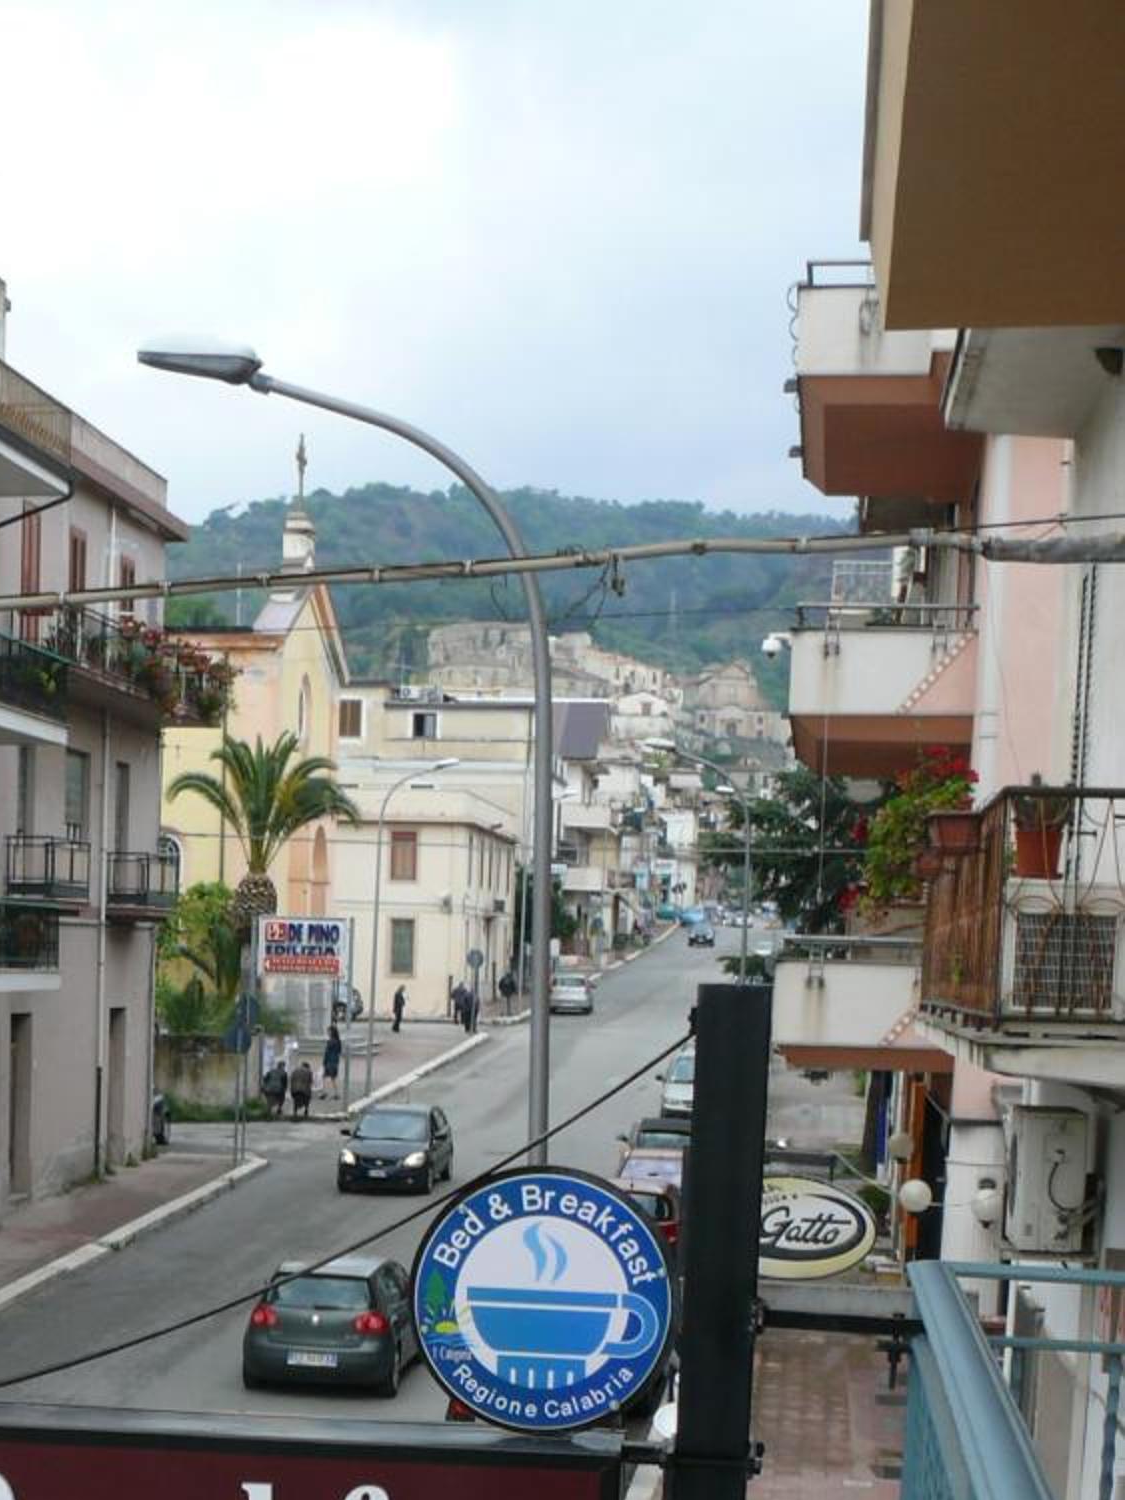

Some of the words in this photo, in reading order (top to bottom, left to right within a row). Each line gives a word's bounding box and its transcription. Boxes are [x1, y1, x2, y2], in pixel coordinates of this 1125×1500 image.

[266, 945, 336, 956] EDILIZIA
[433, 1208, 485, 1269] Bed
[487, 1192, 514, 1221] &
[520, 1184, 660, 1286] Breakfast
[762, 1205, 852, 1246] Gatto
[452, 1363, 539, 1418] Regione
[543, 1367, 635, 1419] Calabria
